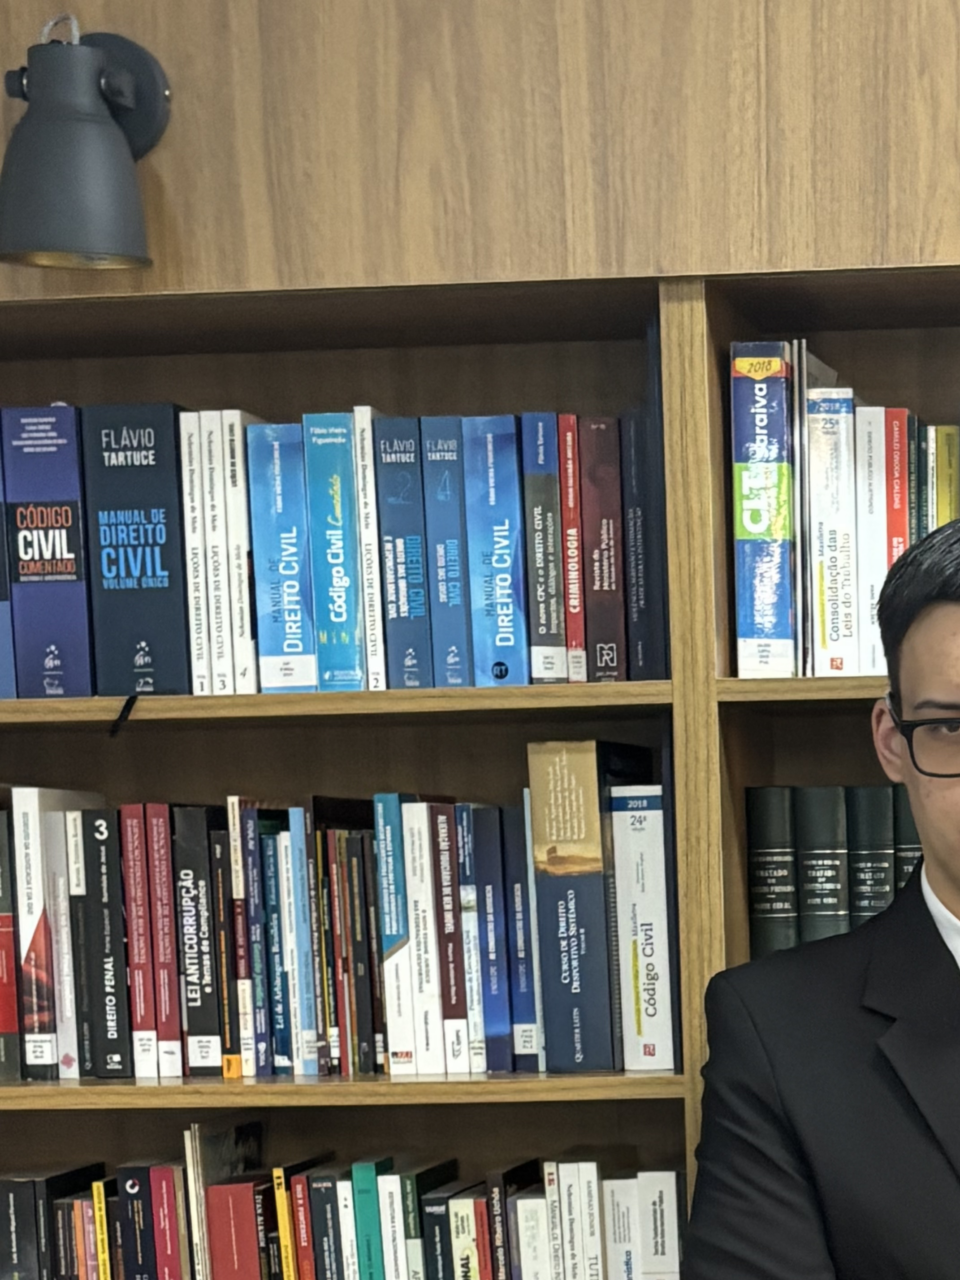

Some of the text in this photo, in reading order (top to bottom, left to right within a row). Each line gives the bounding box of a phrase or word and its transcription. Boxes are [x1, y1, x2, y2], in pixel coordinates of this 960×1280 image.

[100, 426, 156, 450] FLÁVIO
[380, 439, 415, 452] FLÁVIO
[102, 450, 157, 467] TARTUCE
[16, 503, 73, 529] CÓDIGO
[98, 509, 167, 526] MANUAL DE
[99, 524, 167, 547] DIREITO
[17, 529, 75, 561] CIVIL
[278, 526, 299, 575] CIVIL
[326, 530, 344, 564] Civil
[827, 529, 837, 553] das
[18, 560, 76, 575] COMENTADO
[101, 545, 169, 579] CIVIL
[405, 535, 426, 620] DIREITO CIVIL
[445, 539, 461, 607] DIREITO CIVIL
[566, 527, 580, 613] CRIMINOLOGIA
[269, 579, 282, 623] MANUAL
[329, 566, 350, 623] Código
[483, 572, 495, 617] MANUAL
[492, 519, 515, 646] DIREITO CIVIL
[827, 556, 840, 642] Consolidação
[840, 533, 852, 638] Leis do Trabalho
[282, 581, 303, 653] DIREITO
[218, 680, 226, 690] 3
[373, 677, 380, 689] 2
[94, 819, 109, 840] 3
[198, 880, 209, 938] Compliance
[180, 869, 201, 1006] LEI ANTICORRUPÇÃO
[200, 939, 210, 953] de
[201, 954, 211, 985] Temas
[568, 937, 580, 993] DESPORTIVO
[640, 922, 660, 1018] Código Civil
[104, 956, 118, 1039] DIREITO PENAL
